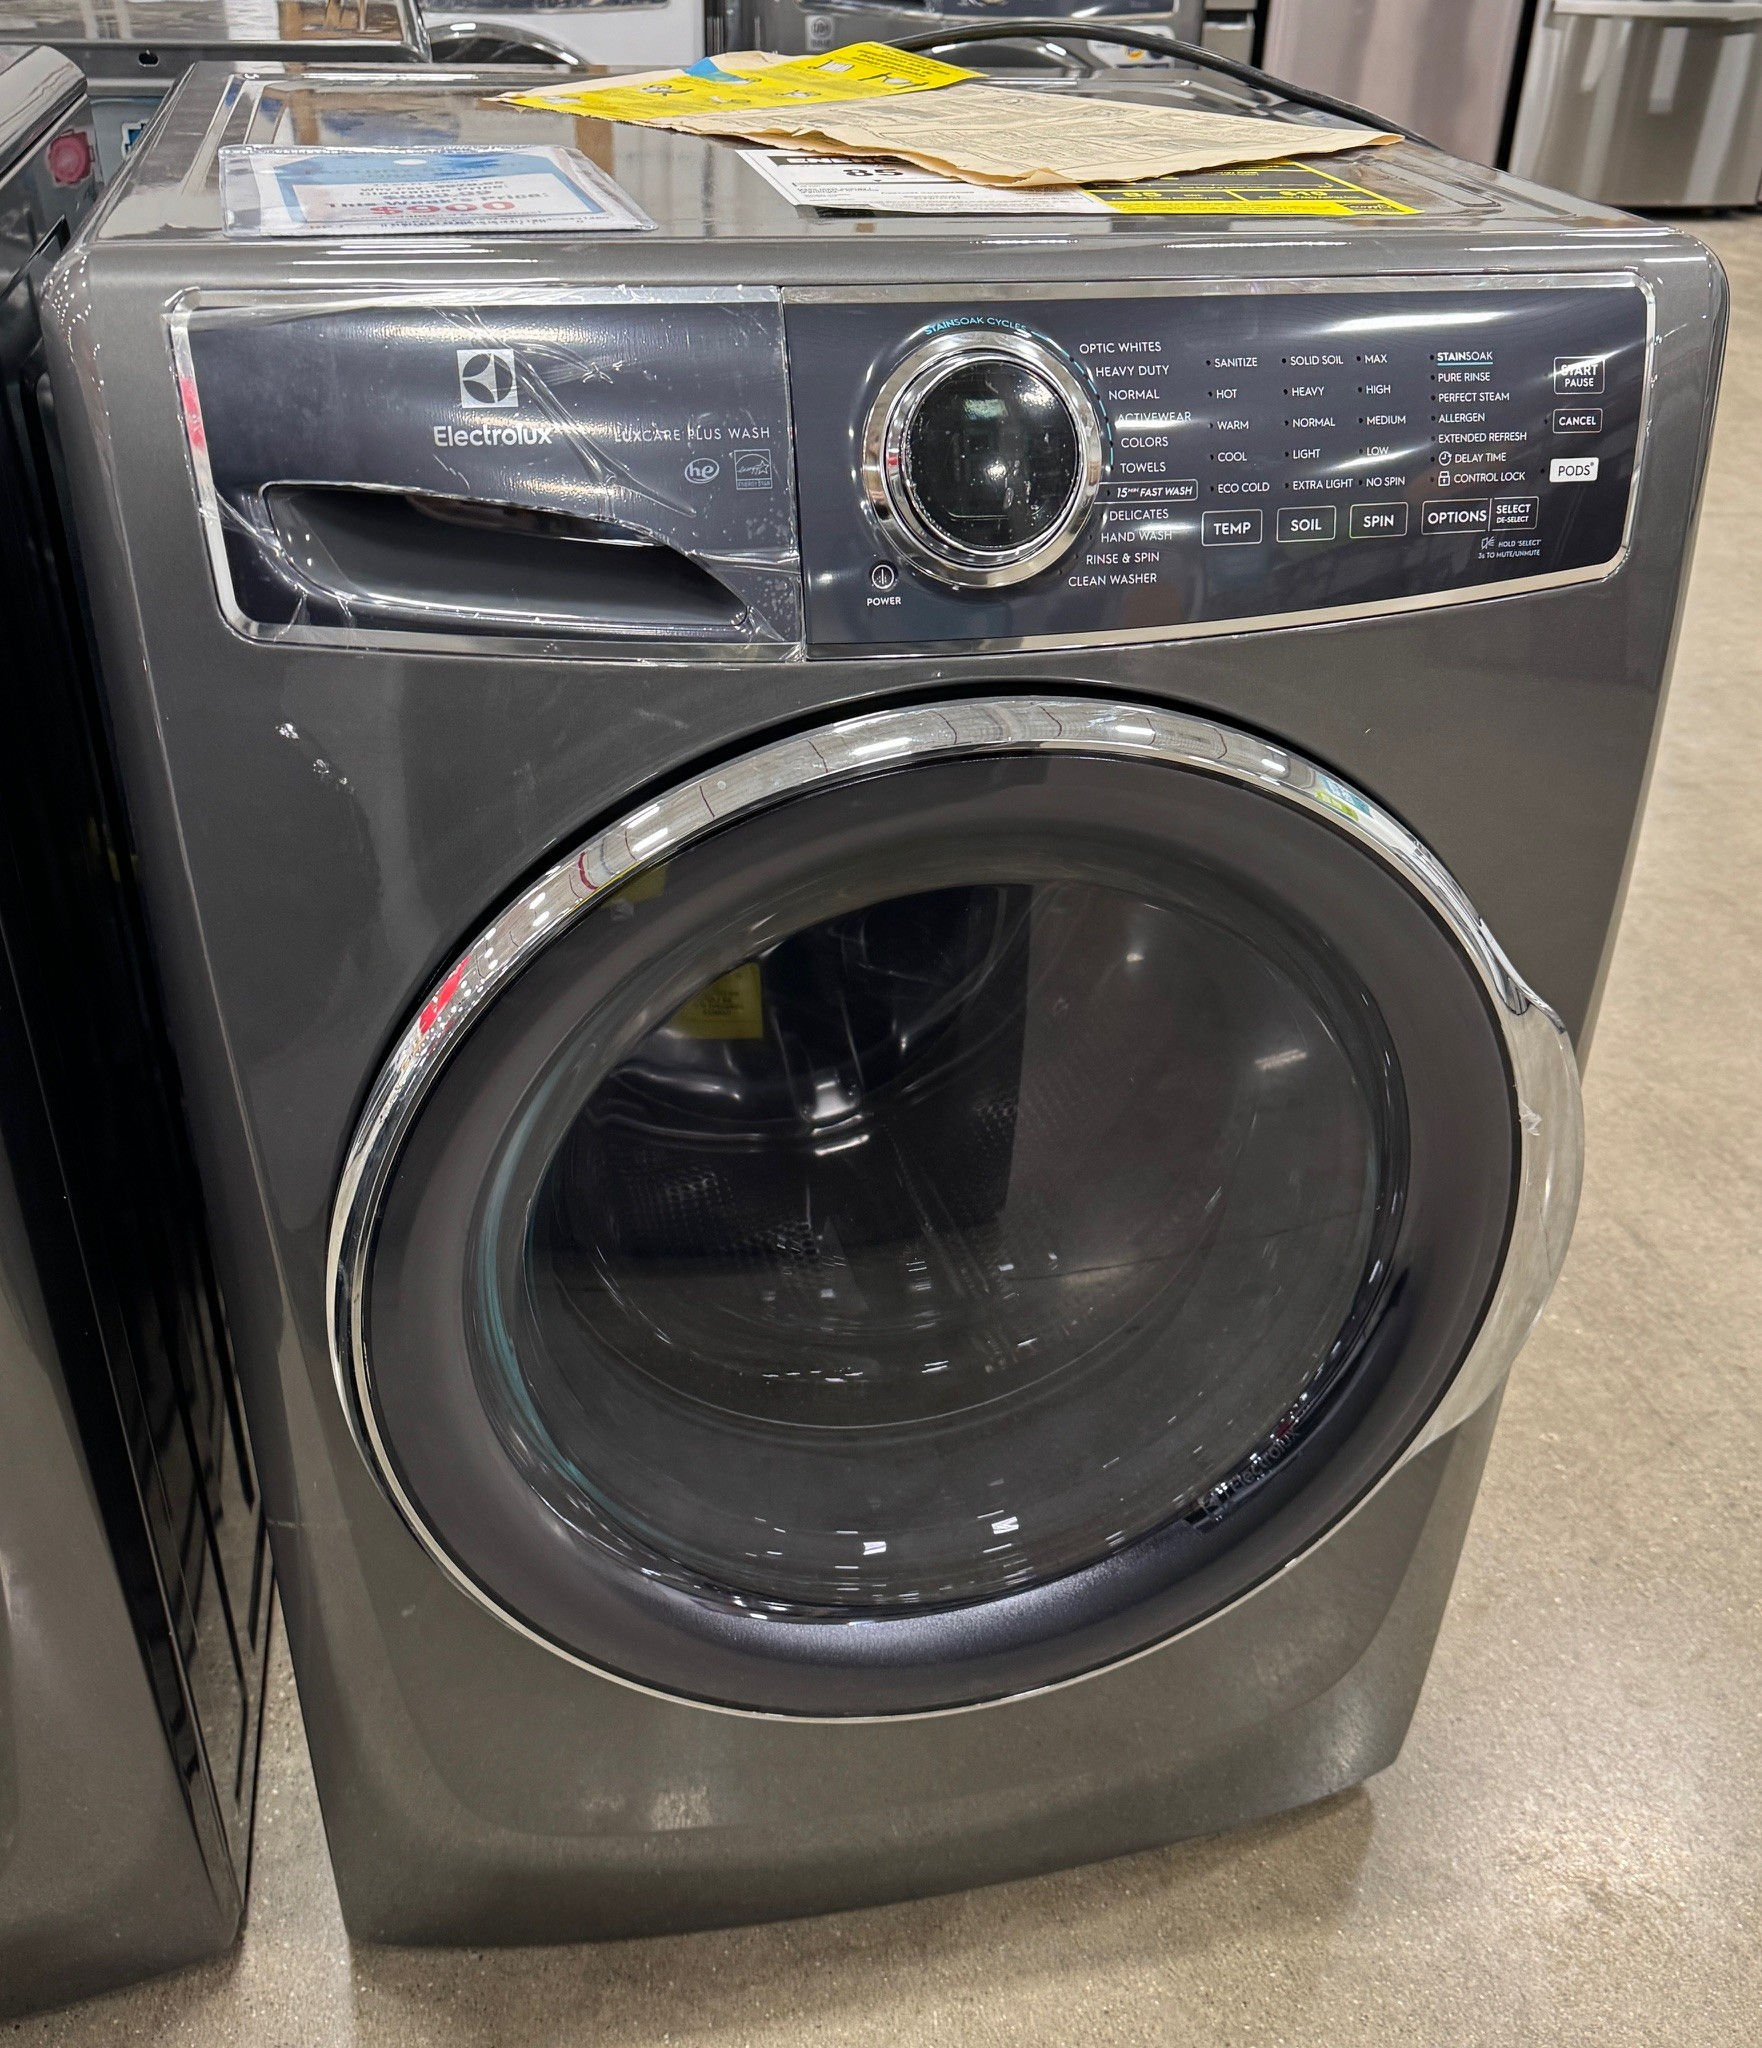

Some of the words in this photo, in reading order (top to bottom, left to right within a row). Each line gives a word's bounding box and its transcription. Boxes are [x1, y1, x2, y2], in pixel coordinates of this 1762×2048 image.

[842, 168, 904, 177] 85
[385, 198, 474, 206] Week's
[369, 202, 516, 215] $900
[924, 316, 985, 335] STAINSOAK
[986, 317, 1027, 332] CYCLES
[1079, 342, 1116, 354] OPTIC
[1118, 341, 1162, 353] WHITES
[1290, 356, 1320, 366] SOLID
[1321, 355, 1344, 365] SOIL
[1365, 354, 1387, 363] MAX
[1437, 351, 1493, 362] STAINSOAK
[1214, 357, 1258, 368] SANITIZE
[1095, 366, 1135, 377] HEAVY
[1137, 365, 1170, 376] DUTY
[1560, 363, 1598, 376] START
[1438, 373, 1462, 382] PURE
[1464, 372, 1491, 382] RINSE
[1564, 378, 1594, 388] PAUSE
[1108, 389, 1160, 401] NORMAL
[1216, 389, 1237, 399] HOT
[1291, 386, 1325, 397] HEAVY
[1366, 385, 1391, 394] HIGH
[1438, 393, 1477, 403] PERFECT
[1479, 392, 1510, 402] STEAM
[1118, 411, 1192, 422] ACTIVEWEAR
[1366, 415, 1406, 425] MEDIUM
[1438, 413, 1485, 423] ALLERGEN
[1558, 416, 1597, 426] CANCEL
[1217, 420, 1249, 430] WARM
[1292, 418, 1336, 428] NORMAL
[433, 424, 552, 447] Electrolux
[614, 429, 681, 443] LUXCARE
[687, 428, 722, 440] PLUS
[728, 427, 770, 439] WASH
[1438, 433, 1487, 443] EXTENDED
[1488, 432, 1527, 442] REFRESH
[1120, 436, 1169, 448] COLORS
[1217, 451, 1248, 462] COOL
[1293, 448, 1321, 459] LIGHT
[1366, 446, 1389, 456] LOW
[1454, 453, 1484, 463] DELAY
[1485, 453, 1507, 462] TIME
[689, 460, 714, 479] he
[1120, 461, 1166, 474] TOWELS
[1366, 477, 1381, 487] NO
[1382, 477, 1406, 487] SPIN
[1454, 473, 1499, 483] CONTROL
[1500, 472, 1525, 482] LOCK
[1217, 484, 1240, 494] ECO
[1241, 482, 1270, 494] COLD
[1292, 479, 1324, 490] EXTRA
[1325, 478, 1353, 489] LIGHT
[1140, 487, 1163, 497] FAST
[1165, 486, 1193, 496] WASH
[1496, 504, 1531, 514] SELECT
[1109, 509, 1169, 521] DELICATES
[1427, 510, 1487, 524] OPTIONS
[1496, 516, 1529, 524] DE-SELECT
[1290, 518, 1322, 531] SOIL
[1363, 514, 1395, 528] SPIN
[1213, 521, 1251, 535] TEMP
[1101, 532, 1135, 543] HAND
[1138, 530, 1172, 541] WASH
[1498, 540, 1516, 548] HOLD
[1086, 553, 1119, 565] RINSE
[1122, 553, 1130, 563] &
[1134, 552, 1160, 563] SPIN
[1496, 549, 1540, 558] MUTE/UNMUTE
[1068, 575, 1106, 587] CLEAN
[1109, 573, 1157, 585] WASHER
[866, 596, 902, 607] POWER
